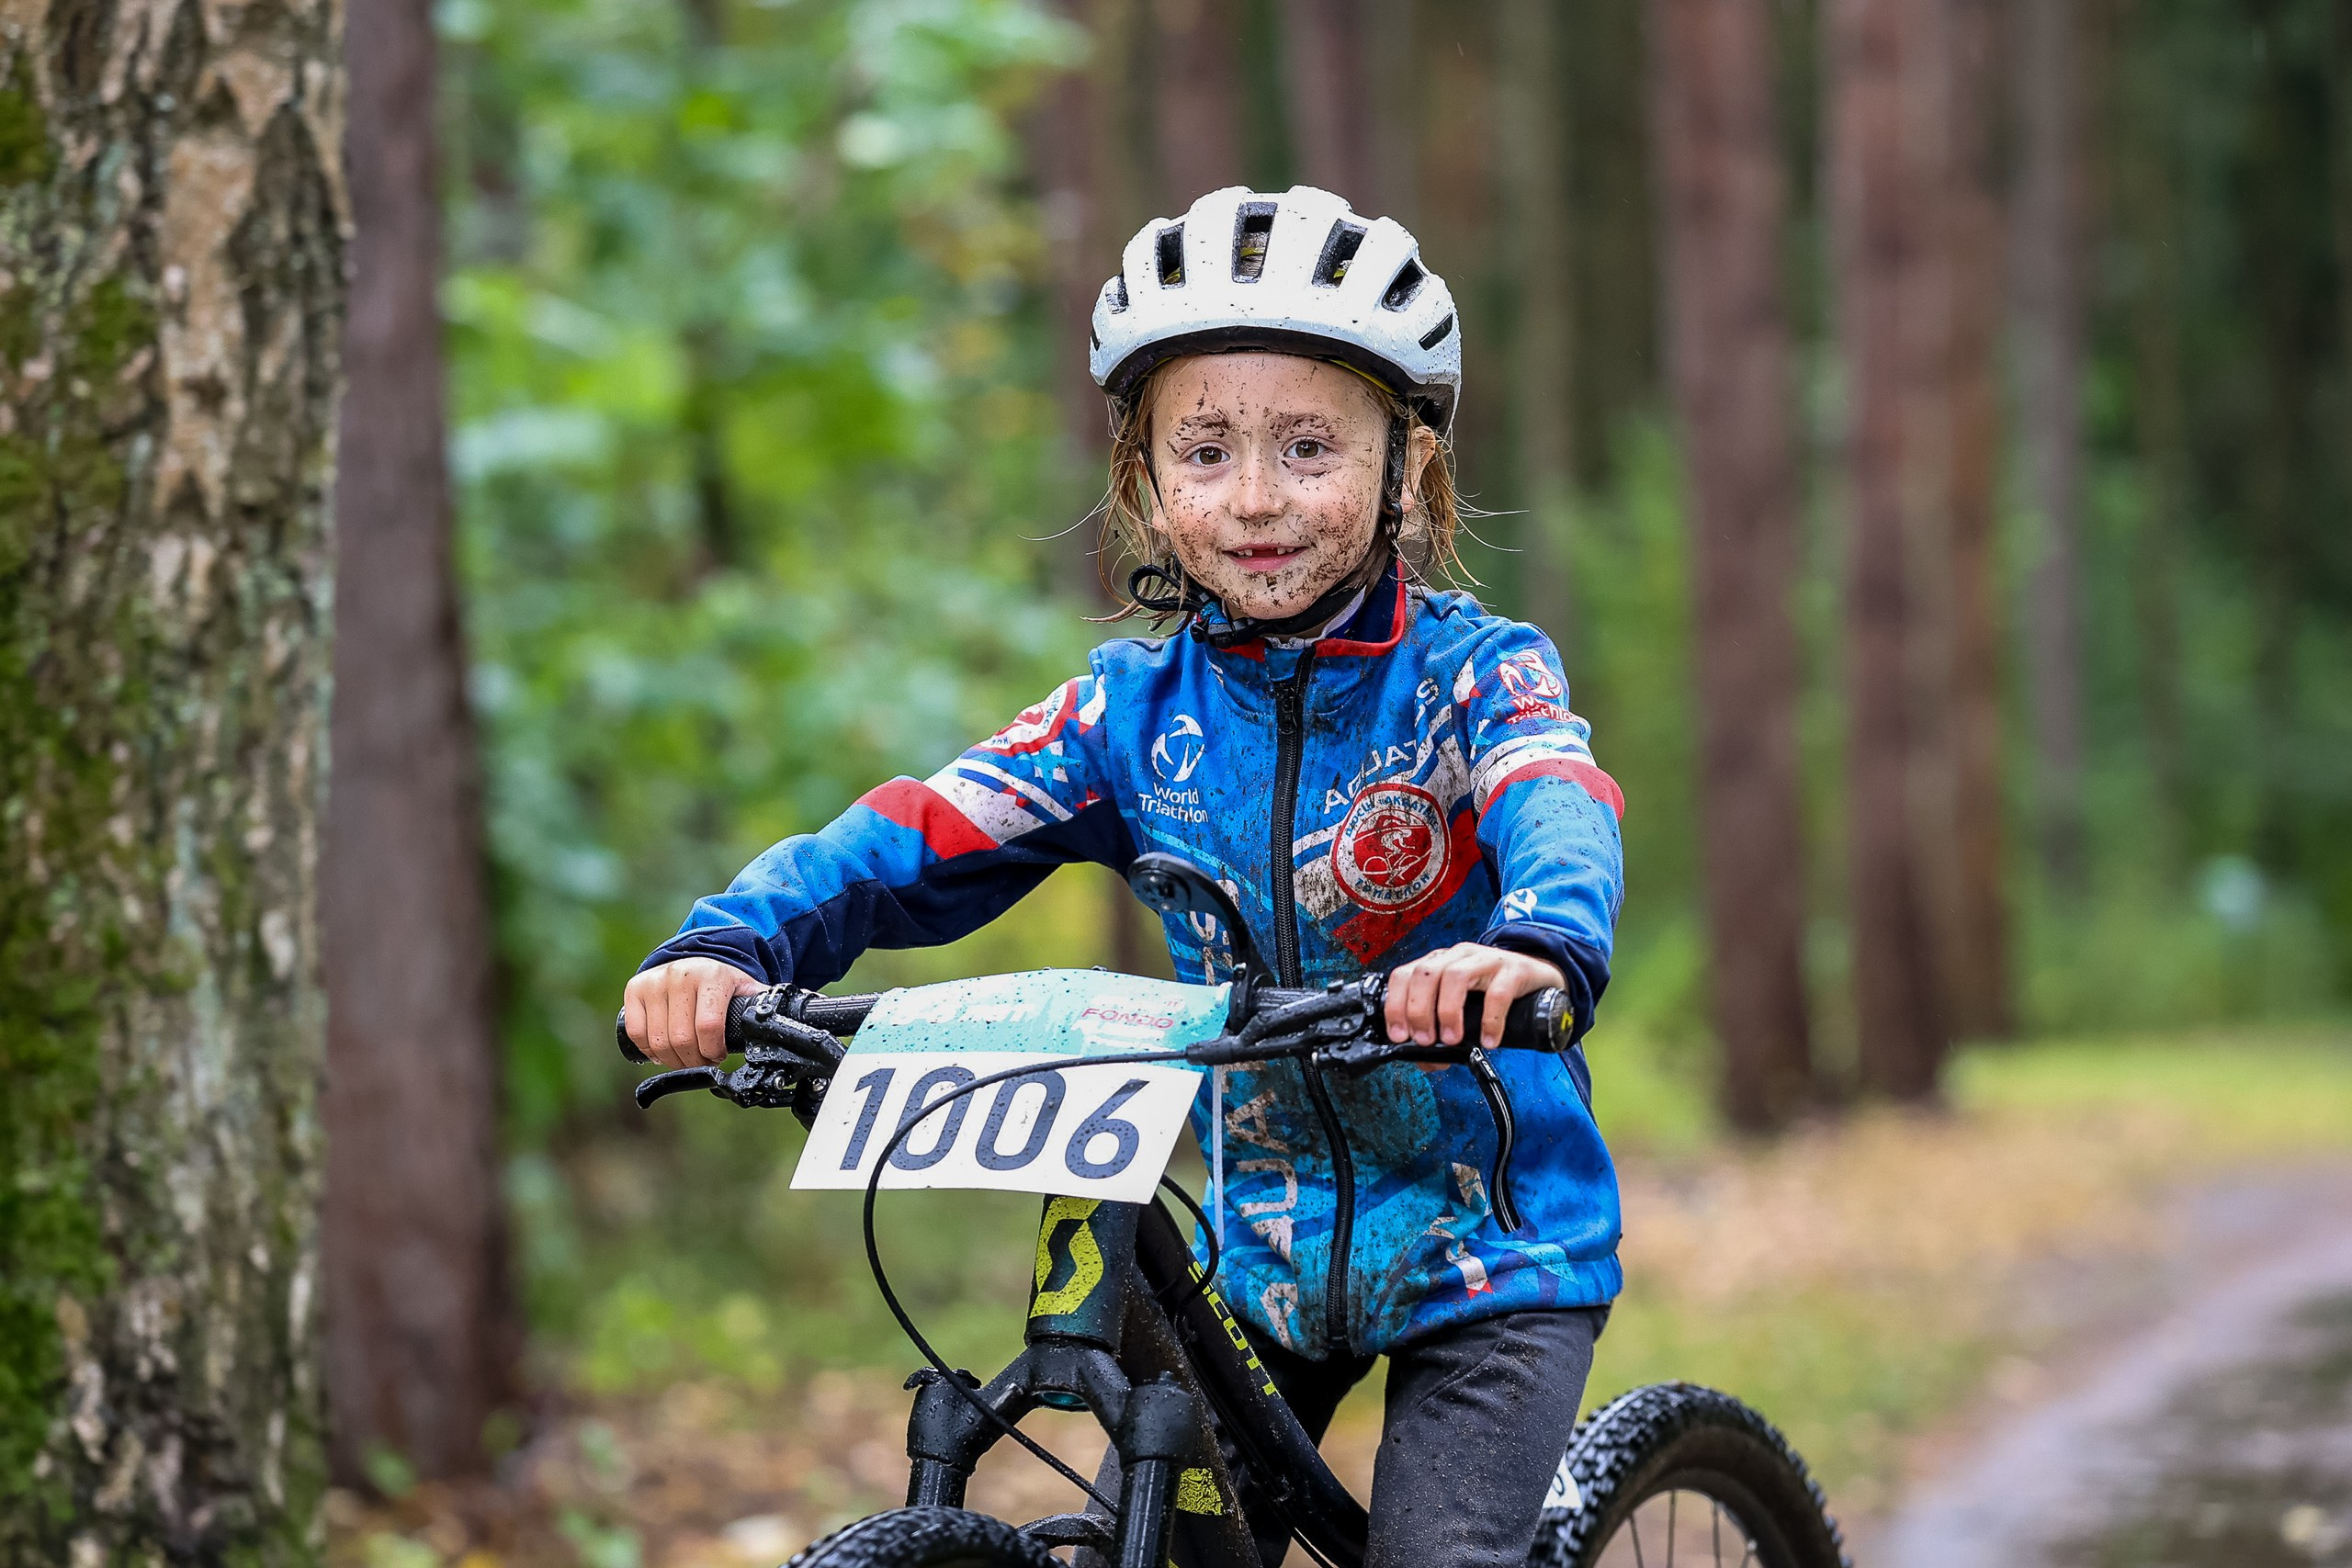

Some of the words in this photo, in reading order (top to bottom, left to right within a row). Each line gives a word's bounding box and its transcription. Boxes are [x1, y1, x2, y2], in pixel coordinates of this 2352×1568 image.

[1138, 793, 1209, 823] Triathlon
[1153, 782, 1199, 805] World
[839, 1066, 1149, 1179] 1006
